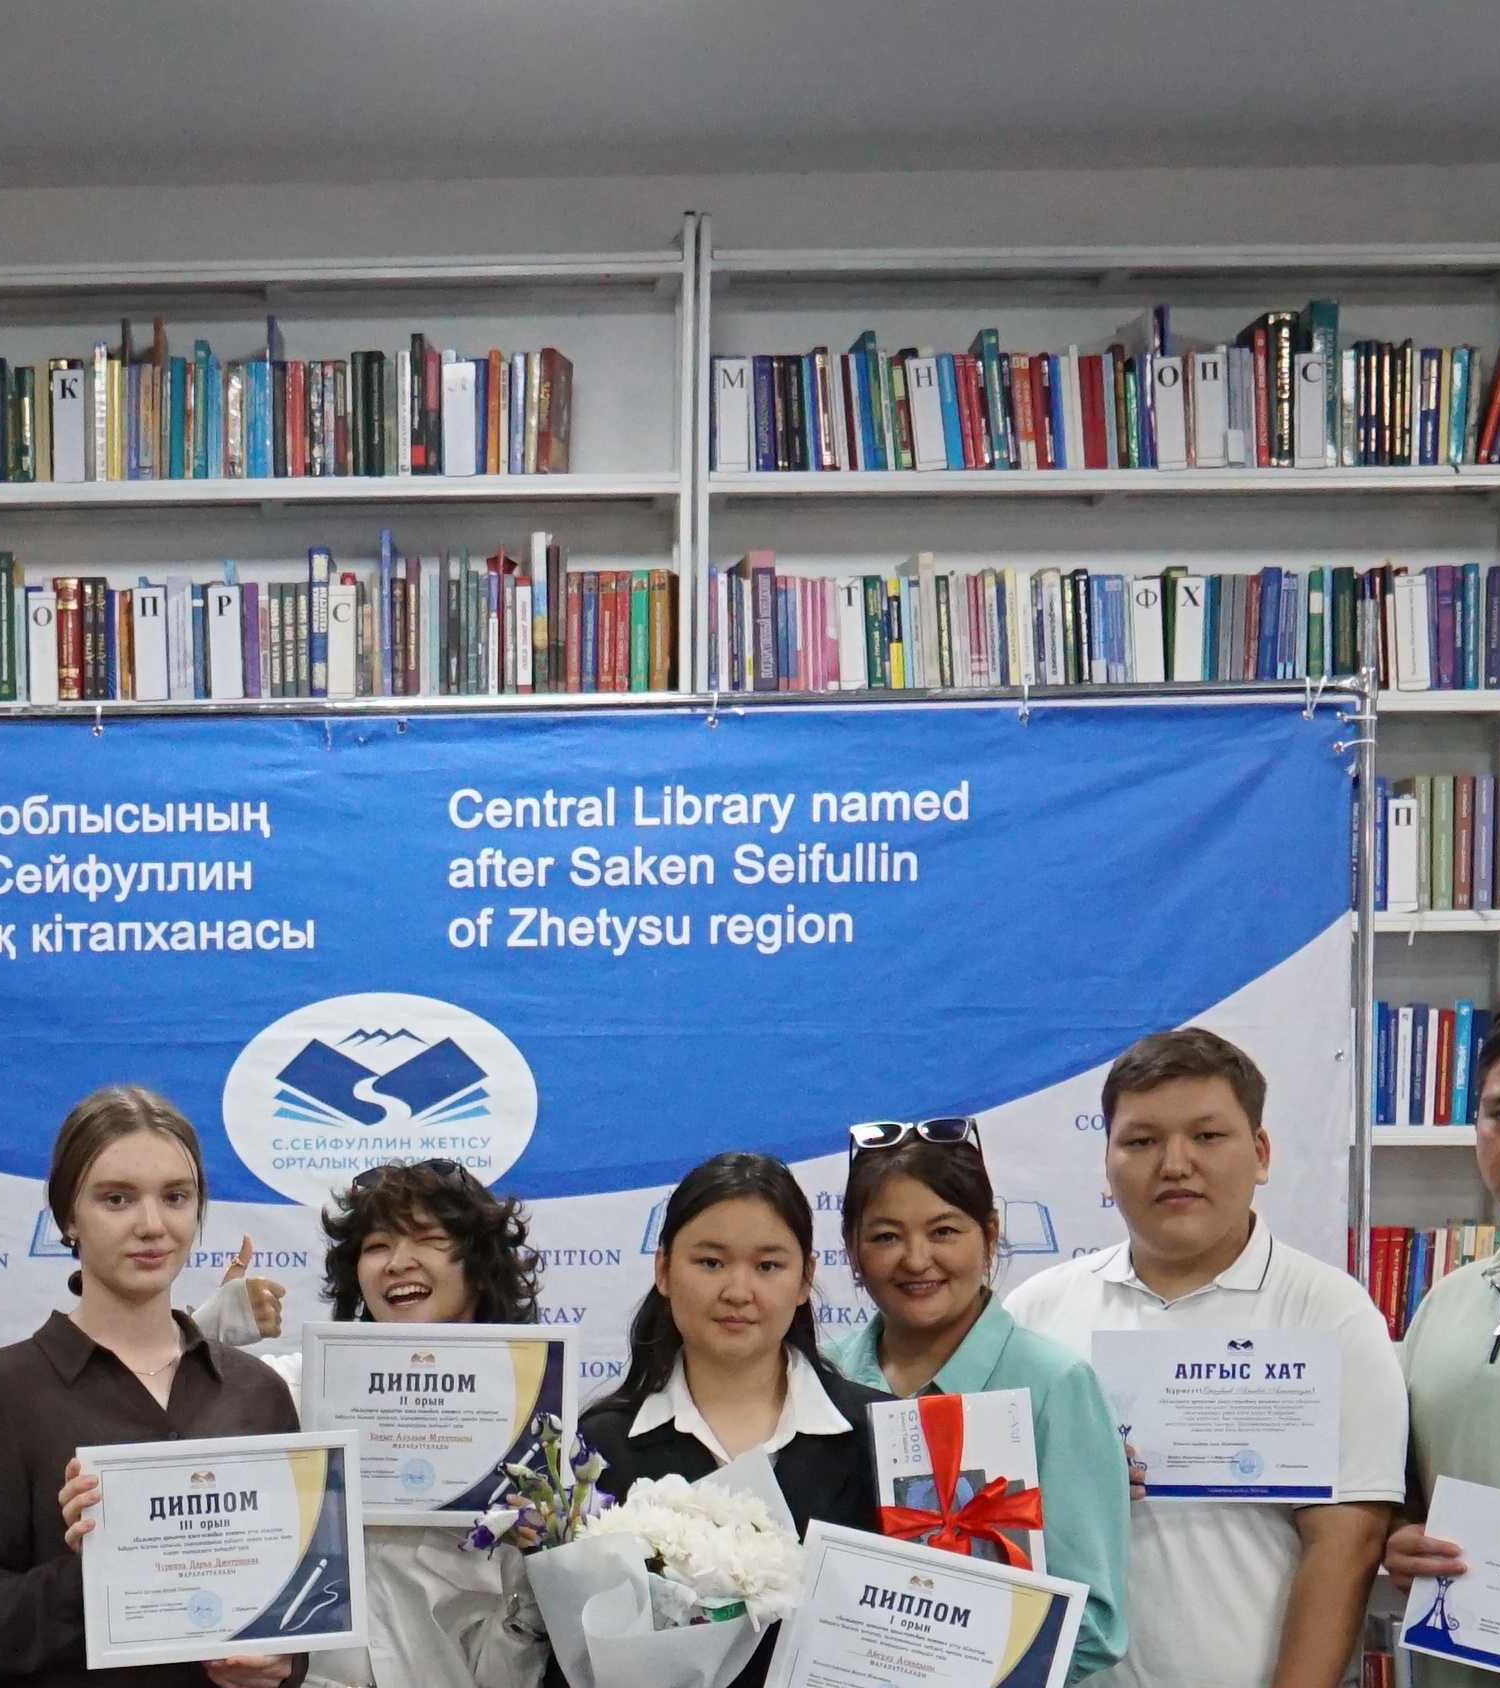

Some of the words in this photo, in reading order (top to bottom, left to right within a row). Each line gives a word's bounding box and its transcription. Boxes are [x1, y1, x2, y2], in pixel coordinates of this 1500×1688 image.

[721, 367, 744, 389] М
[915, 366, 933, 388] Н
[1157, 365, 1180, 387] О
[1201, 361, 1219, 381] П
[1300, 361, 1321, 384] С
[60, 377, 78, 399] К
[140, 596, 158, 617] П
[217, 595, 231, 617] Р
[1135, 588, 1158, 609] Ф
[1182, 586, 1199, 607] Х
[32, 606, 53, 627] О
[332, 602, 351, 623] С
[449, 787, 615, 829] Central
[635, 785, 795, 834] Library
[812, 780, 969, 824] named
[1393, 807, 1412, 827] П
[448, 848, 554, 888] after
[569, 845, 715, 887] Saken
[733, 841, 919, 885] Seifullin
[32, 914, 315, 953] кітапханасы
[448, 908, 493, 948] of
[507, 907, 690, 955] Zhetysu
[710, 905, 853, 954] region
[272, 1136, 411, 1151] С.СЕЙФУЛЛИН
[420, 1136, 491, 1150] ЖЕТІСУ
[272, 1155, 360, 1172] ОРТАЛЫҚ
[1174, 1363, 1251, 1380] АЛҒЫС
[1264, 1362, 1307, 1380] ХАТ
[368, 1372, 477, 1395] ДИПЛОМ
[415, 1396, 445, 1408] орын
[150, 1490, 259, 1521] ДИПЛОМ
[200, 1519, 231, 1532] орын
[858, 1583, 972, 1629] ДИПЛОМ
[900, 1617, 932, 1634] орын
